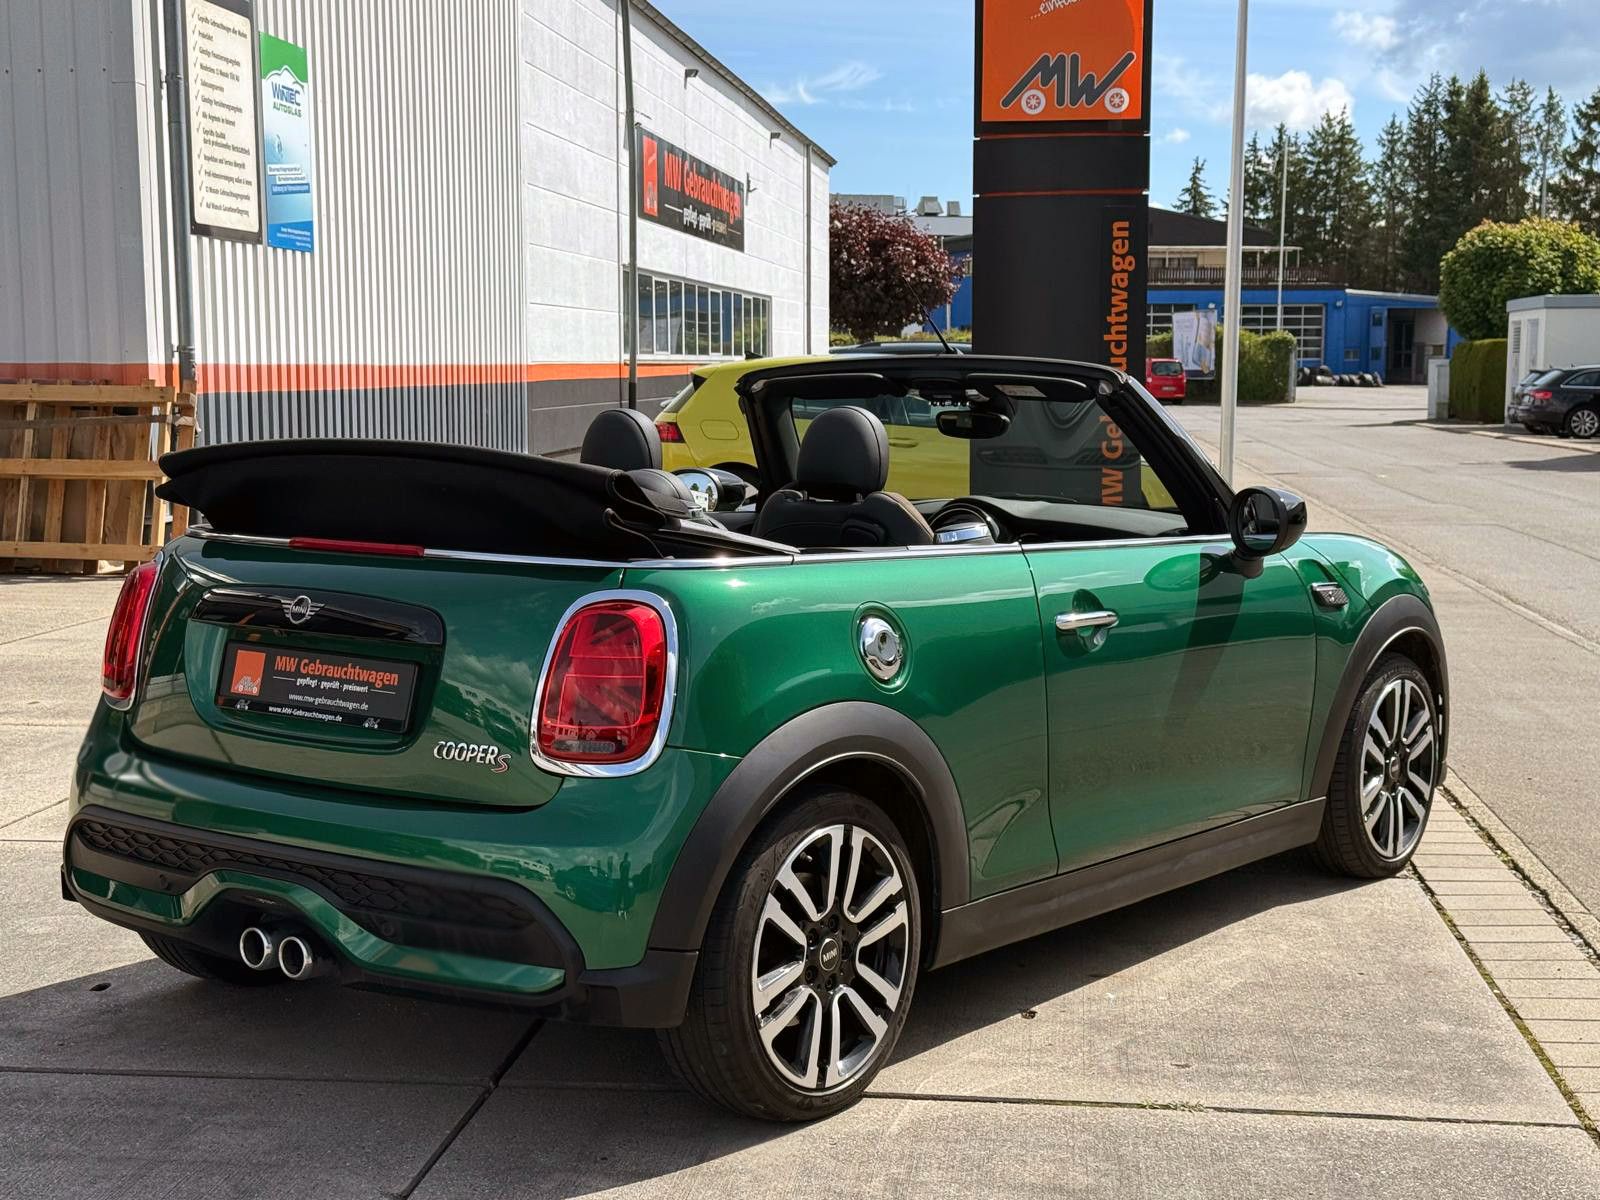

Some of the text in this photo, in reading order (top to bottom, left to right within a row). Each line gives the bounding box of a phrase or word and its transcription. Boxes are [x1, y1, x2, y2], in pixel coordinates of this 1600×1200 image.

[1001, 51, 1136, 109] MW
[273, 101, 302, 118] AUTOGLAS
[664, 149, 682, 192] MW
[683, 160, 742, 225] Gebrauchtwagen
[274, 655, 399, 688] MW Gebrauchtwagen
[296, 677, 318, 688] gepflegt
[343, 682, 368, 693] preiswert
[288, 692, 369, 712] www.mw-gebrauchtwagen.de
[433, 740, 512, 774] COOPER S
[822, 947, 838, 963] MINI
